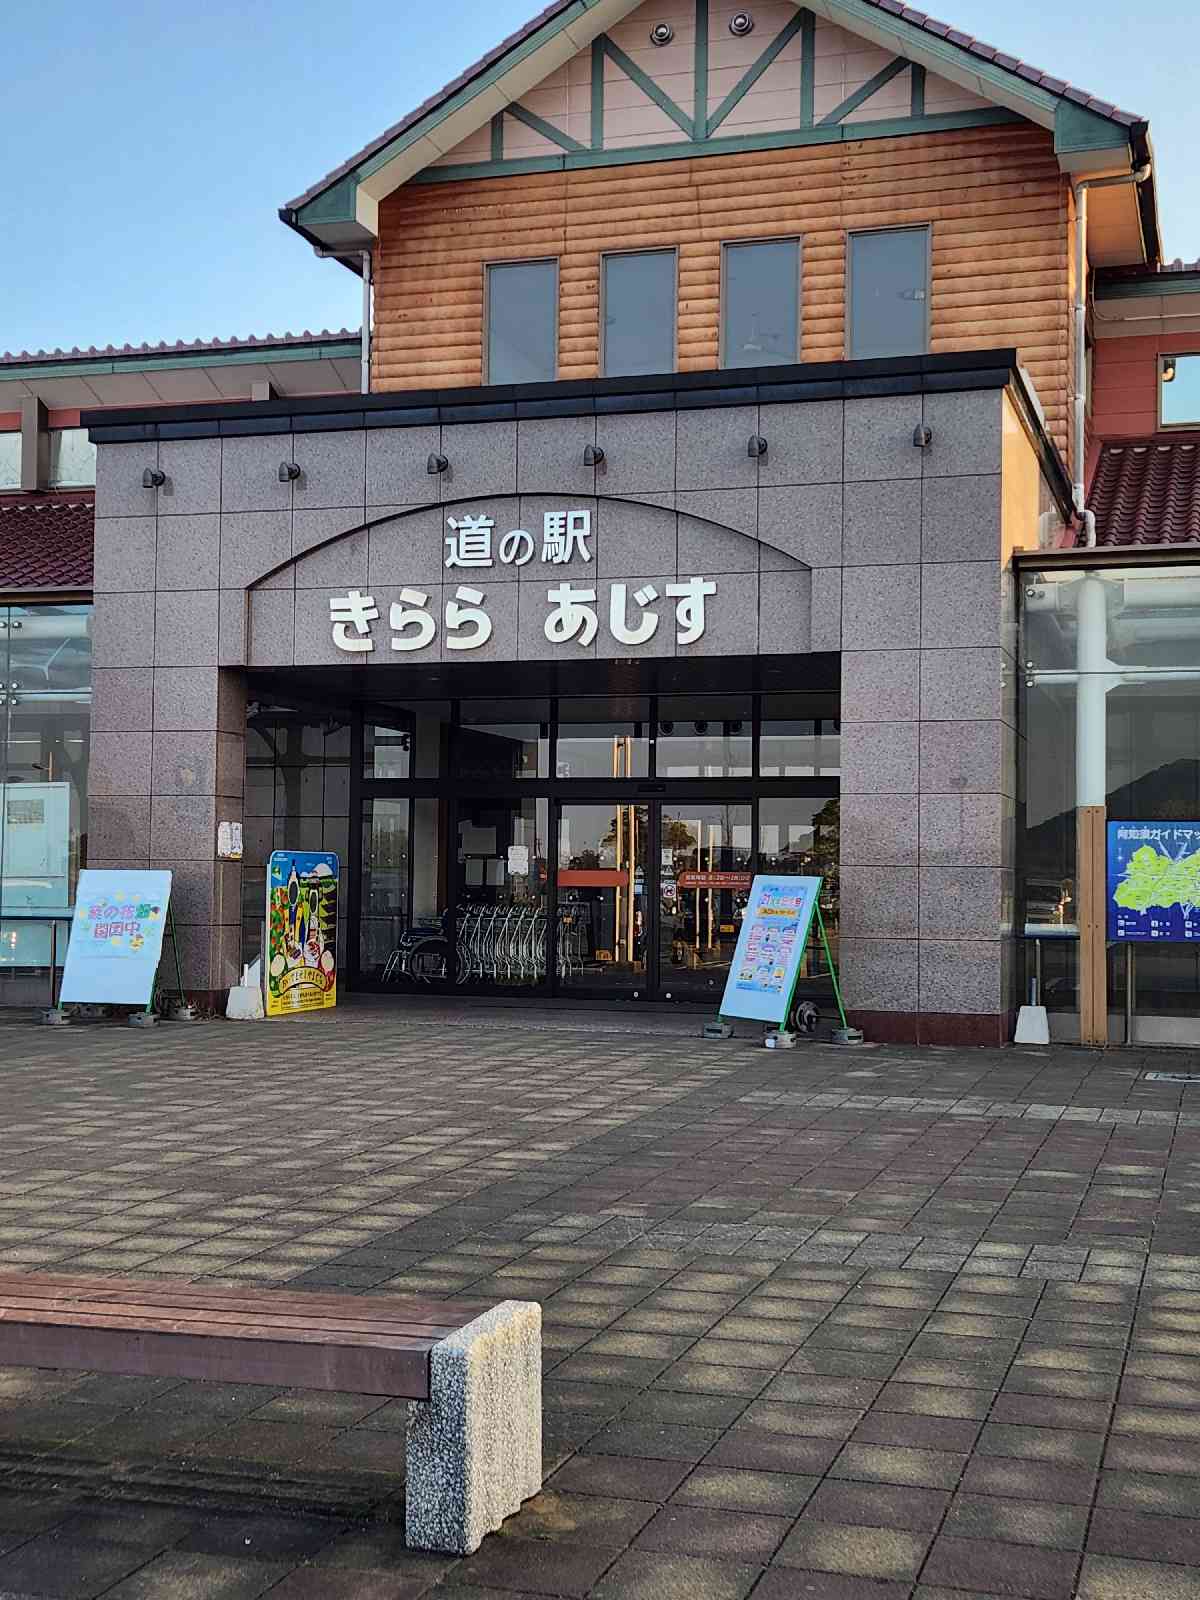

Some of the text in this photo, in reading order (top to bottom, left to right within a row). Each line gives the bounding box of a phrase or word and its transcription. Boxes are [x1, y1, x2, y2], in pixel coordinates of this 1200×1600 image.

[445, 510, 592, 568] 道の駅
[329, 577, 717, 652] きらら あじす
